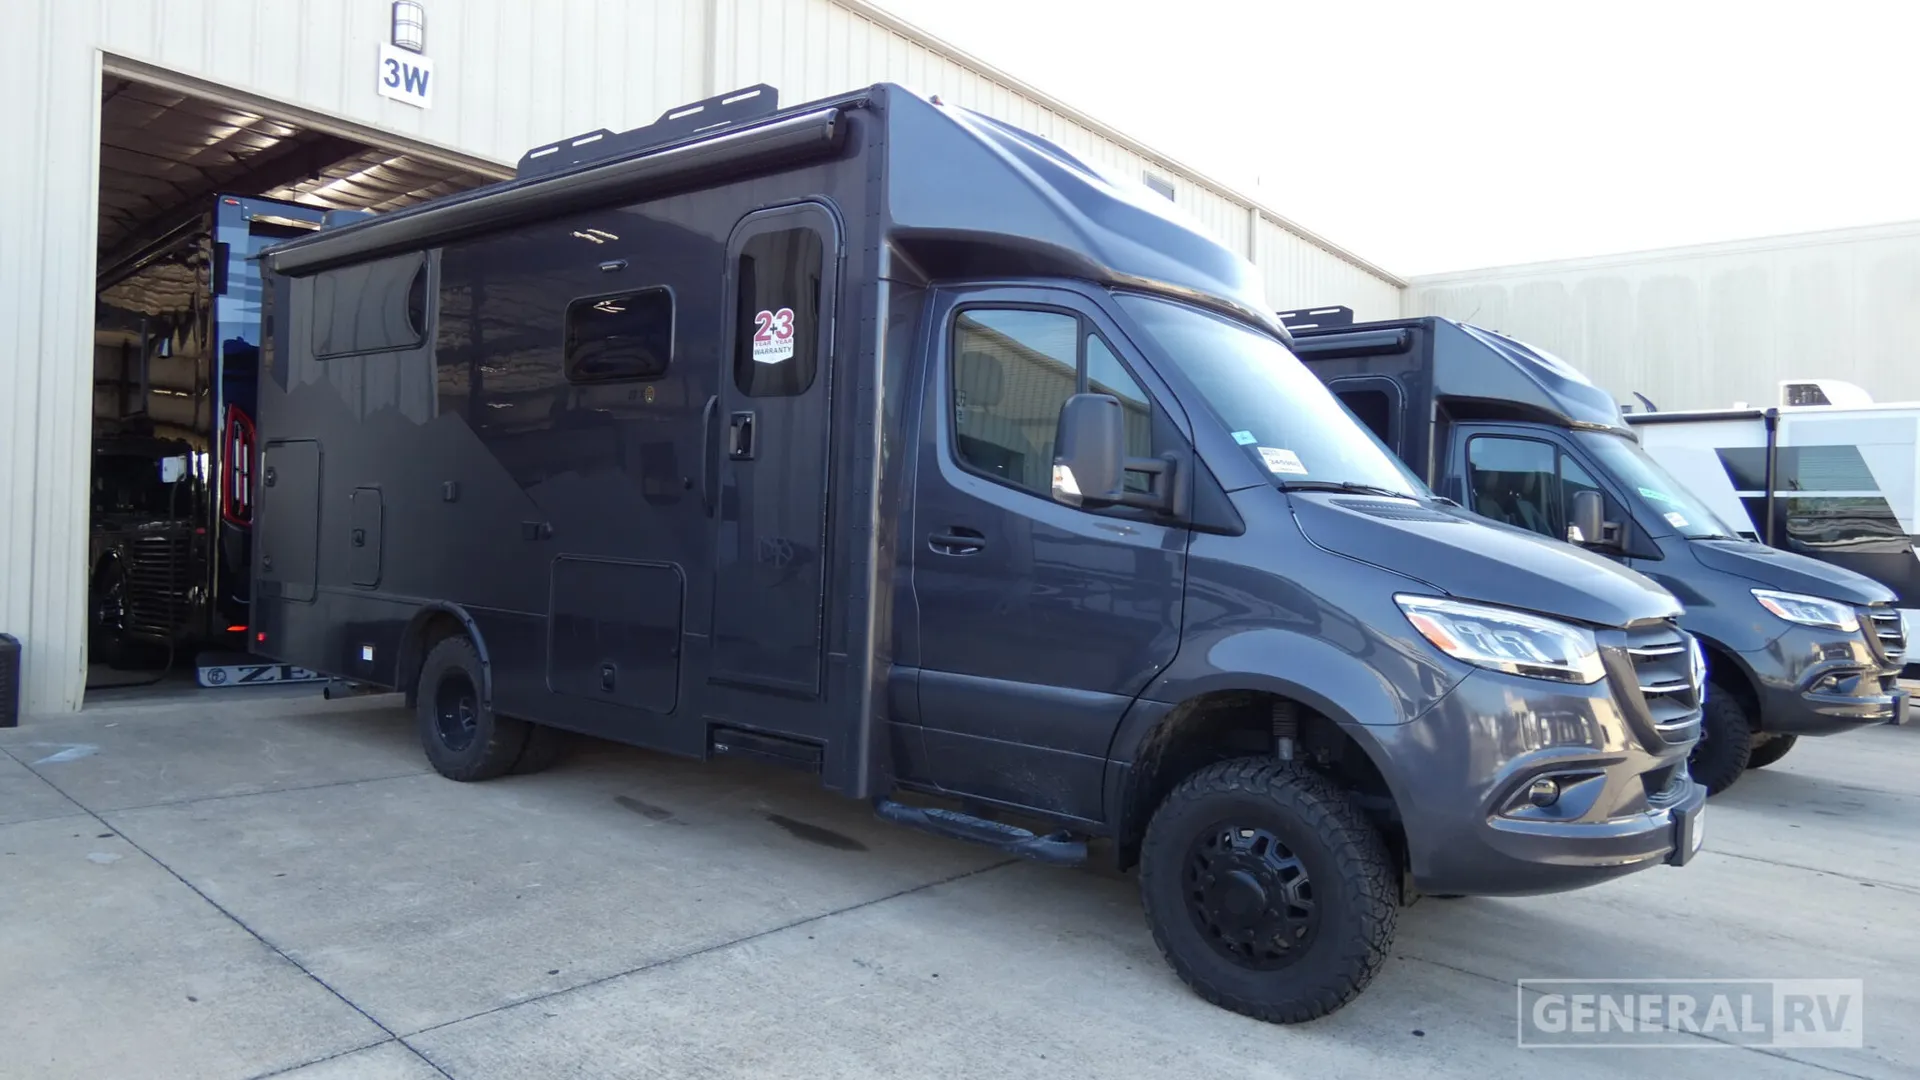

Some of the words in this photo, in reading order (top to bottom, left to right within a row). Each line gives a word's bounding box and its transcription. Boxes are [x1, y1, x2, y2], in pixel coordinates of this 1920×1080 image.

[383, 57, 430, 97] 3W
[754, 346, 792, 356] WARRANTY
[237, 664, 329, 684] ZE
